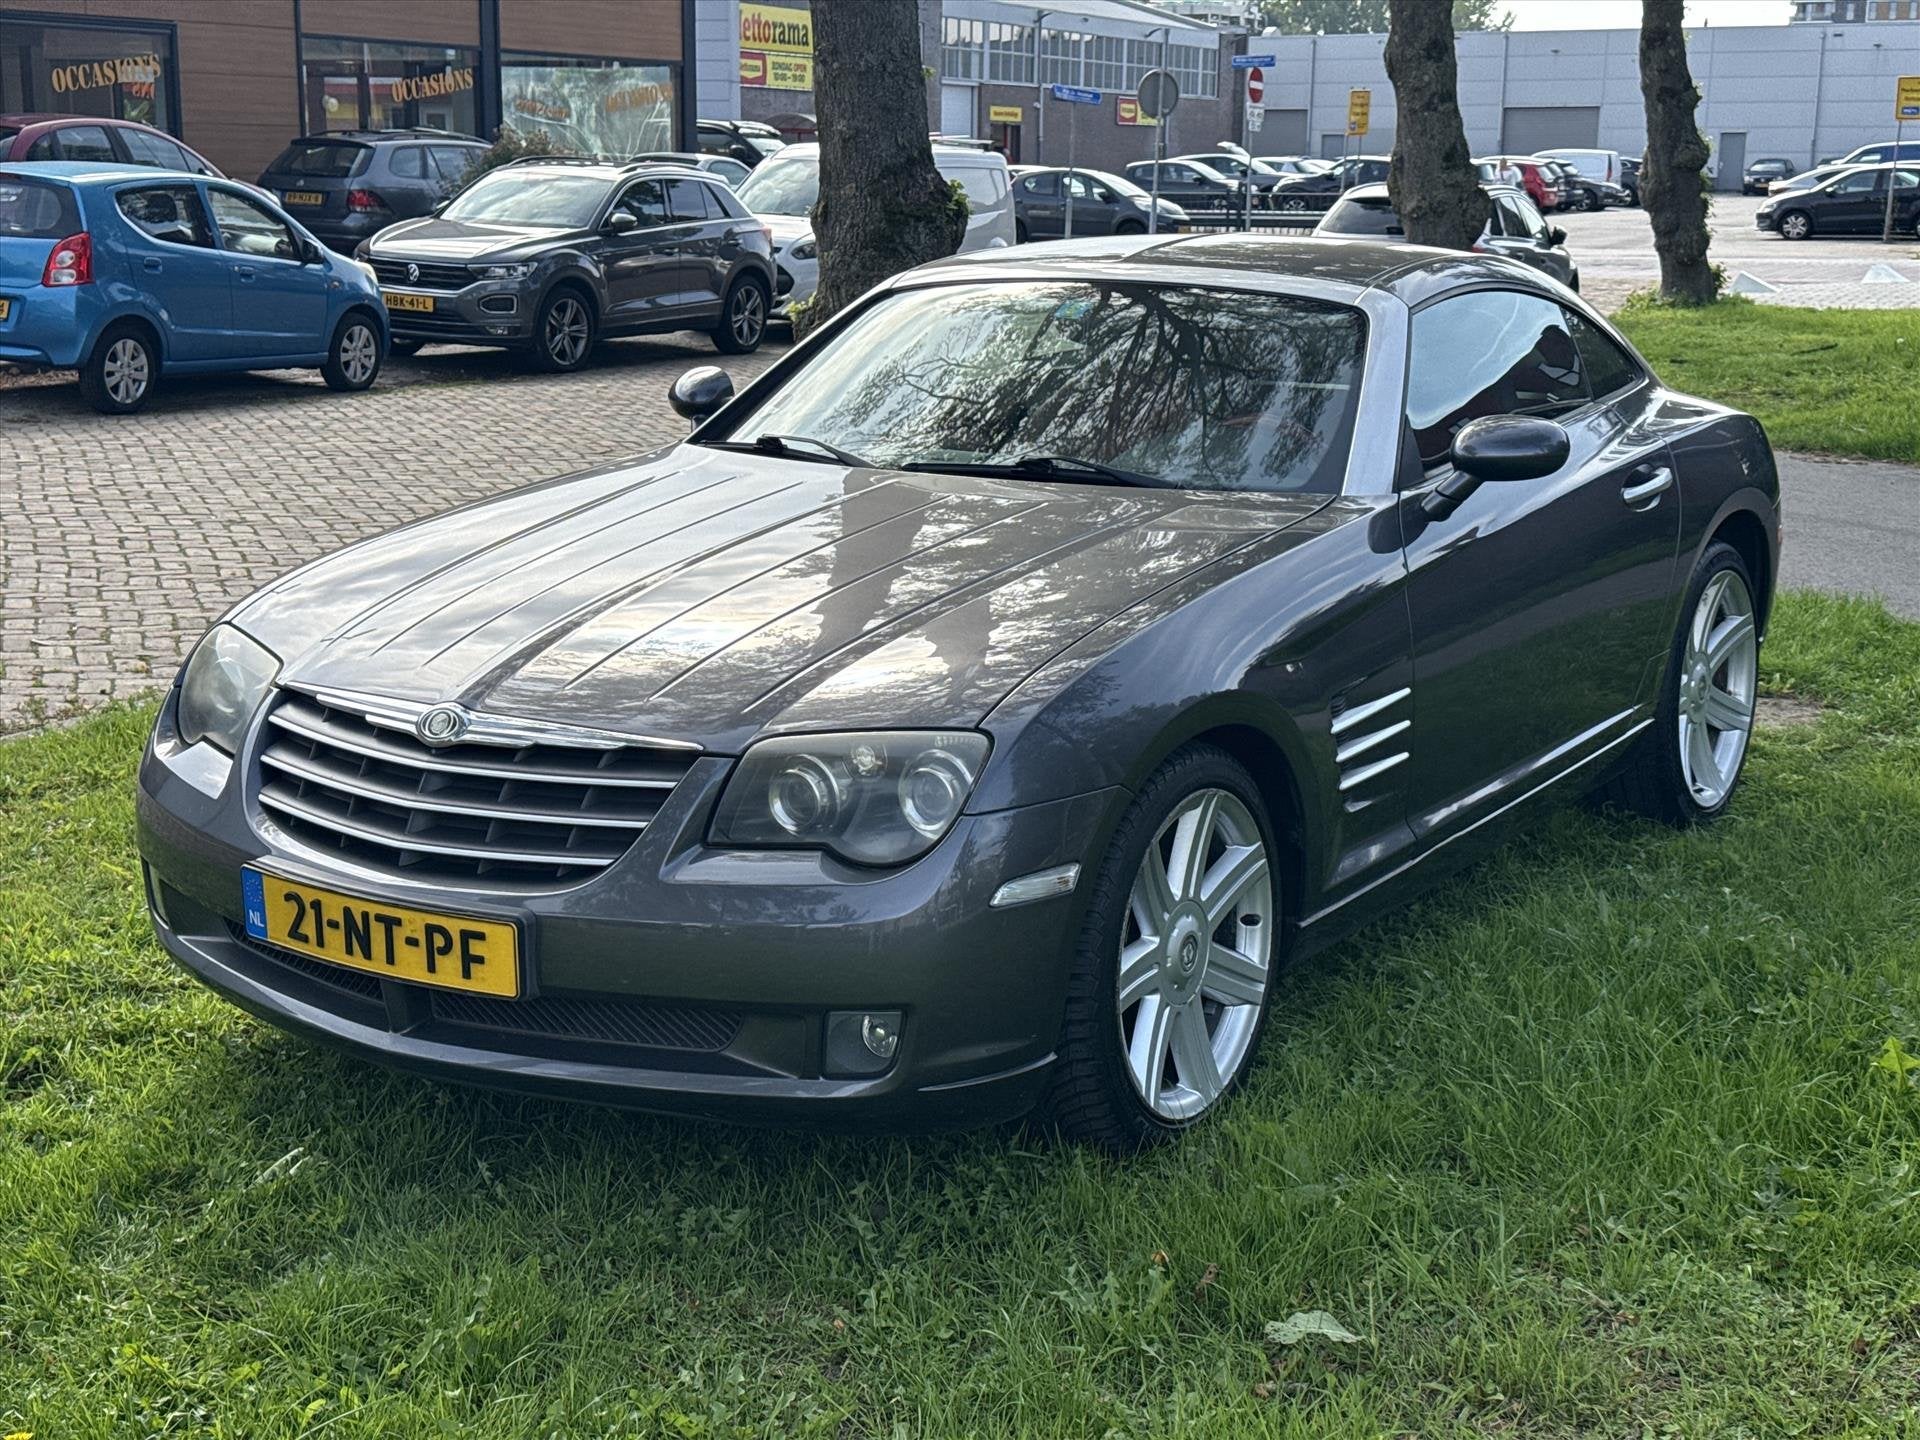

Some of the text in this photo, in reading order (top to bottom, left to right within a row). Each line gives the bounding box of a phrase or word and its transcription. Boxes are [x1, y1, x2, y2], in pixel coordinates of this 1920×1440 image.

[740, 11, 809, 47] ettorama
[52, 54, 160, 92] OCCASIONS
[392, 68, 473, 102] OCCASIONS
[385, 294, 429, 310] HBK-41-L
[249, 909, 264, 928] NL
[283, 891, 486, 980] 21-NT-PF
